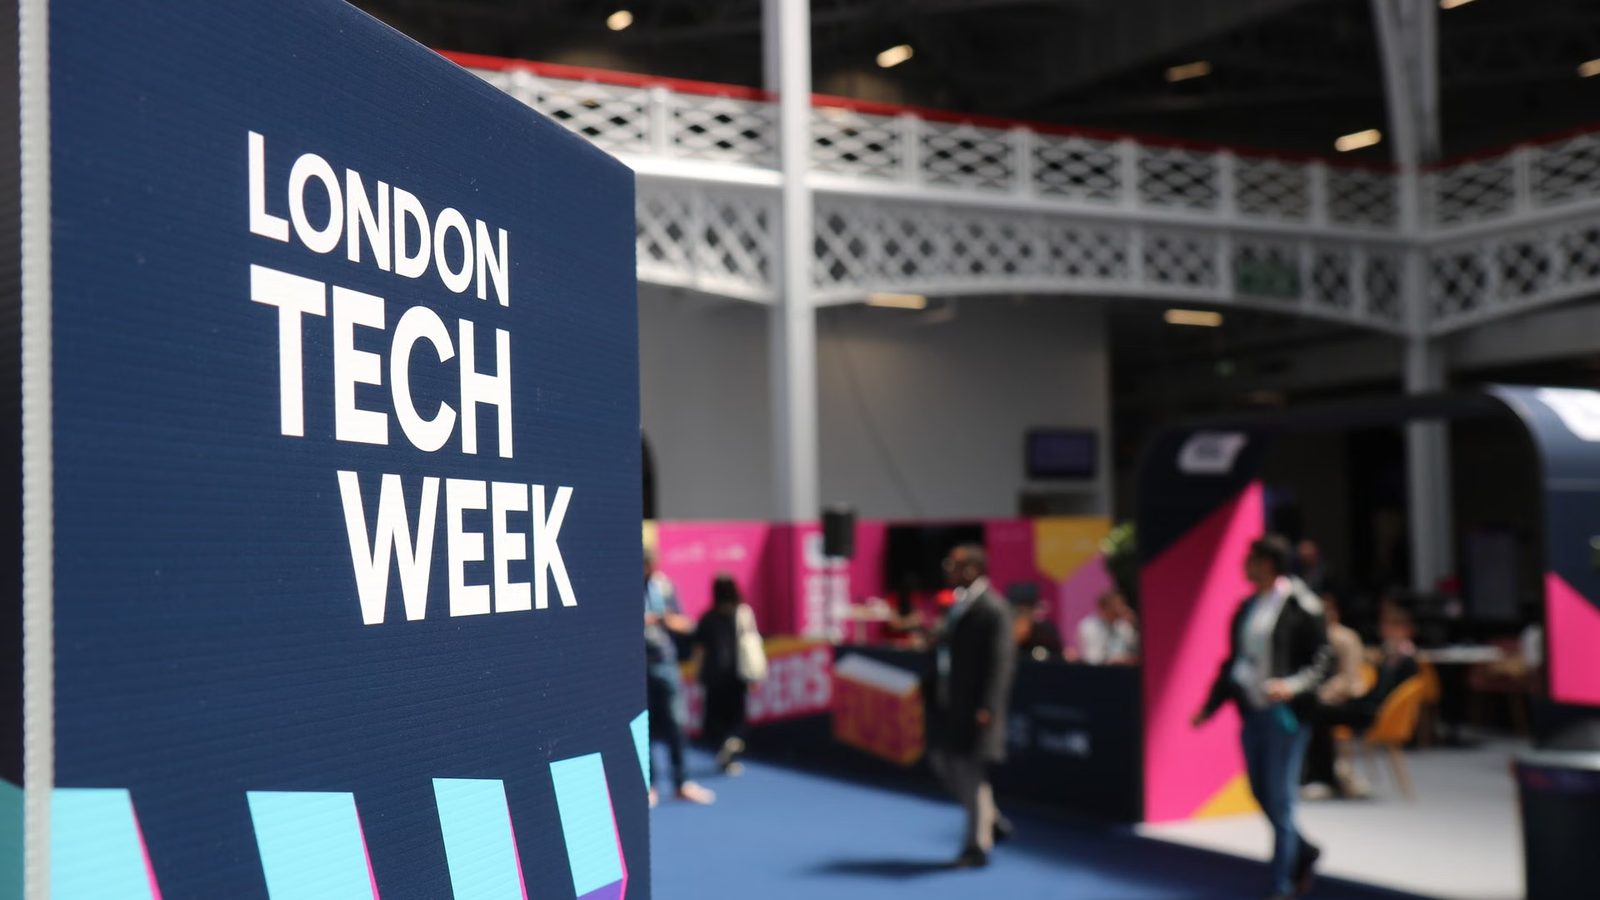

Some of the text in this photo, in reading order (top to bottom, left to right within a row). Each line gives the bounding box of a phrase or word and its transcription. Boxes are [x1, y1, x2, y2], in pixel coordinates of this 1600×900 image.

[248, 130, 510, 308] LONDON
[250, 263, 514, 459] TECH
[336, 470, 578, 626] WEEK
